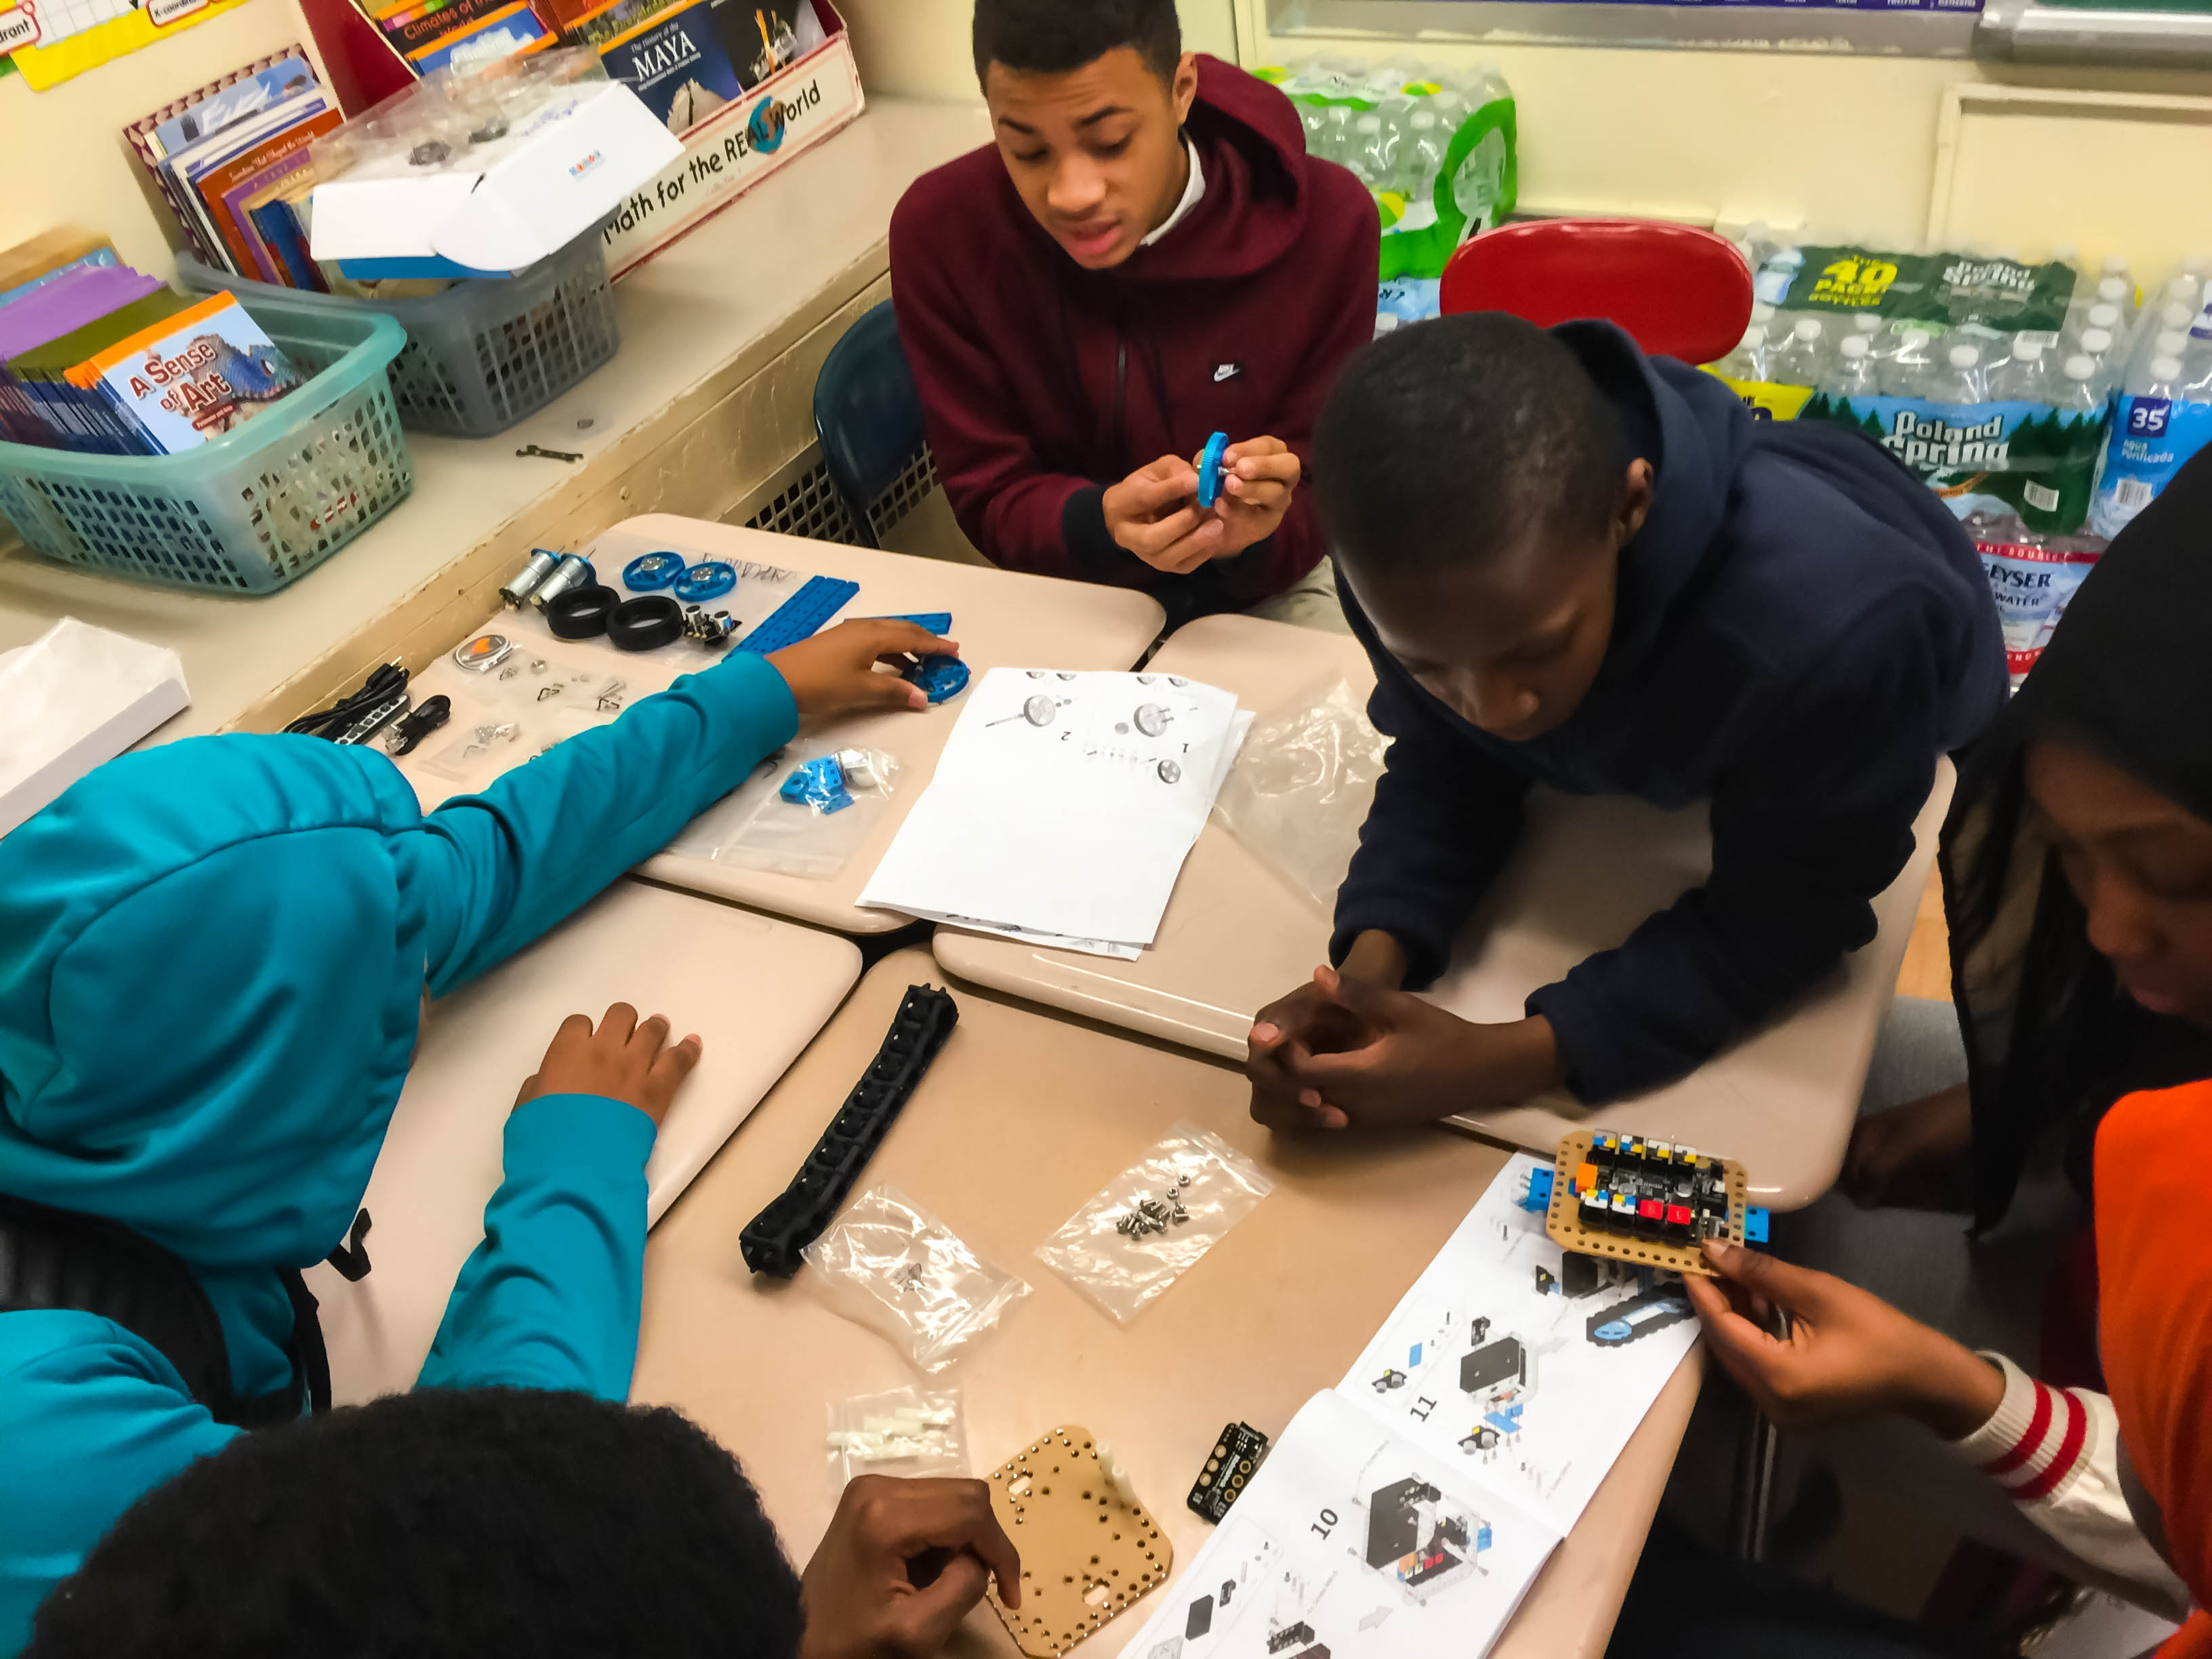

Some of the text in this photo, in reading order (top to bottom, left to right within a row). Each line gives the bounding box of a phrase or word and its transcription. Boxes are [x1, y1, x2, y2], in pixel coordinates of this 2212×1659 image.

[403, 7, 458, 40] Climates
[632, 30, 697, 82] MAYA
[656, 180, 685, 209] for
[689, 153, 724, 184] the
[769, 78, 821, 131] World
[1823, 259, 1898, 287] 40
[129, 342, 216, 400] A Sense
[159, 371, 232, 413] of Art
[1893, 411, 2004, 443] Poland
[2133, 407, 2171, 432] 35
[1881, 434, 2010, 472] Spring
[1994, 591, 2040, 607] WATER
[1410, 1396, 1437, 1422] 11
[1311, 1509, 1338, 1540] 10
